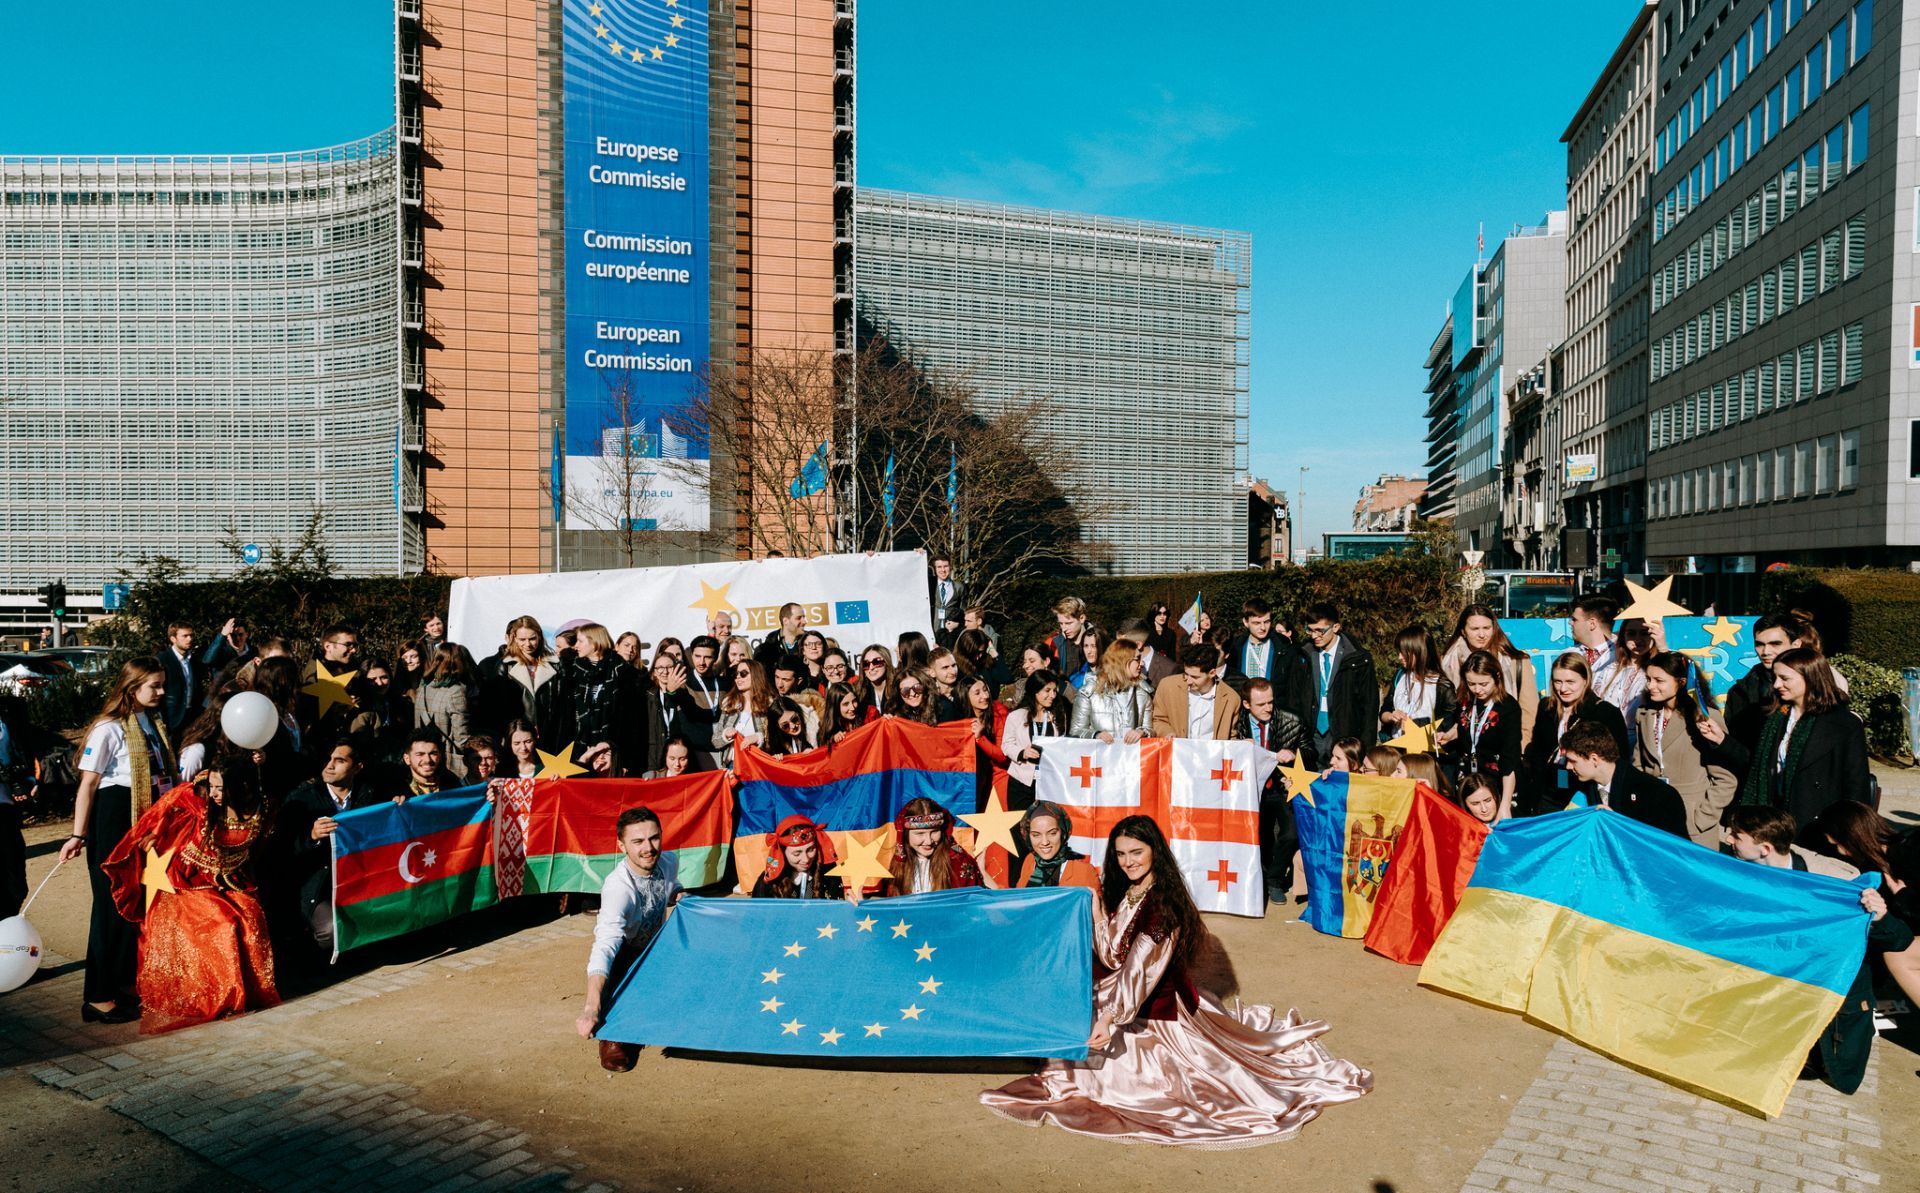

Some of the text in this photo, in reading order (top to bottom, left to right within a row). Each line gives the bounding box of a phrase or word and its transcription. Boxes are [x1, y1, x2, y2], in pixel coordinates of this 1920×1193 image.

[596, 136, 679, 163] Europese
[589, 164, 686, 191] Commissie
[583, 229, 692, 256] Commission
[585, 261, 690, 283] européenne
[596, 321, 680, 345] European
[584, 349, 692, 373] Commission
[1526, 576, 1558, 585] Brussels
